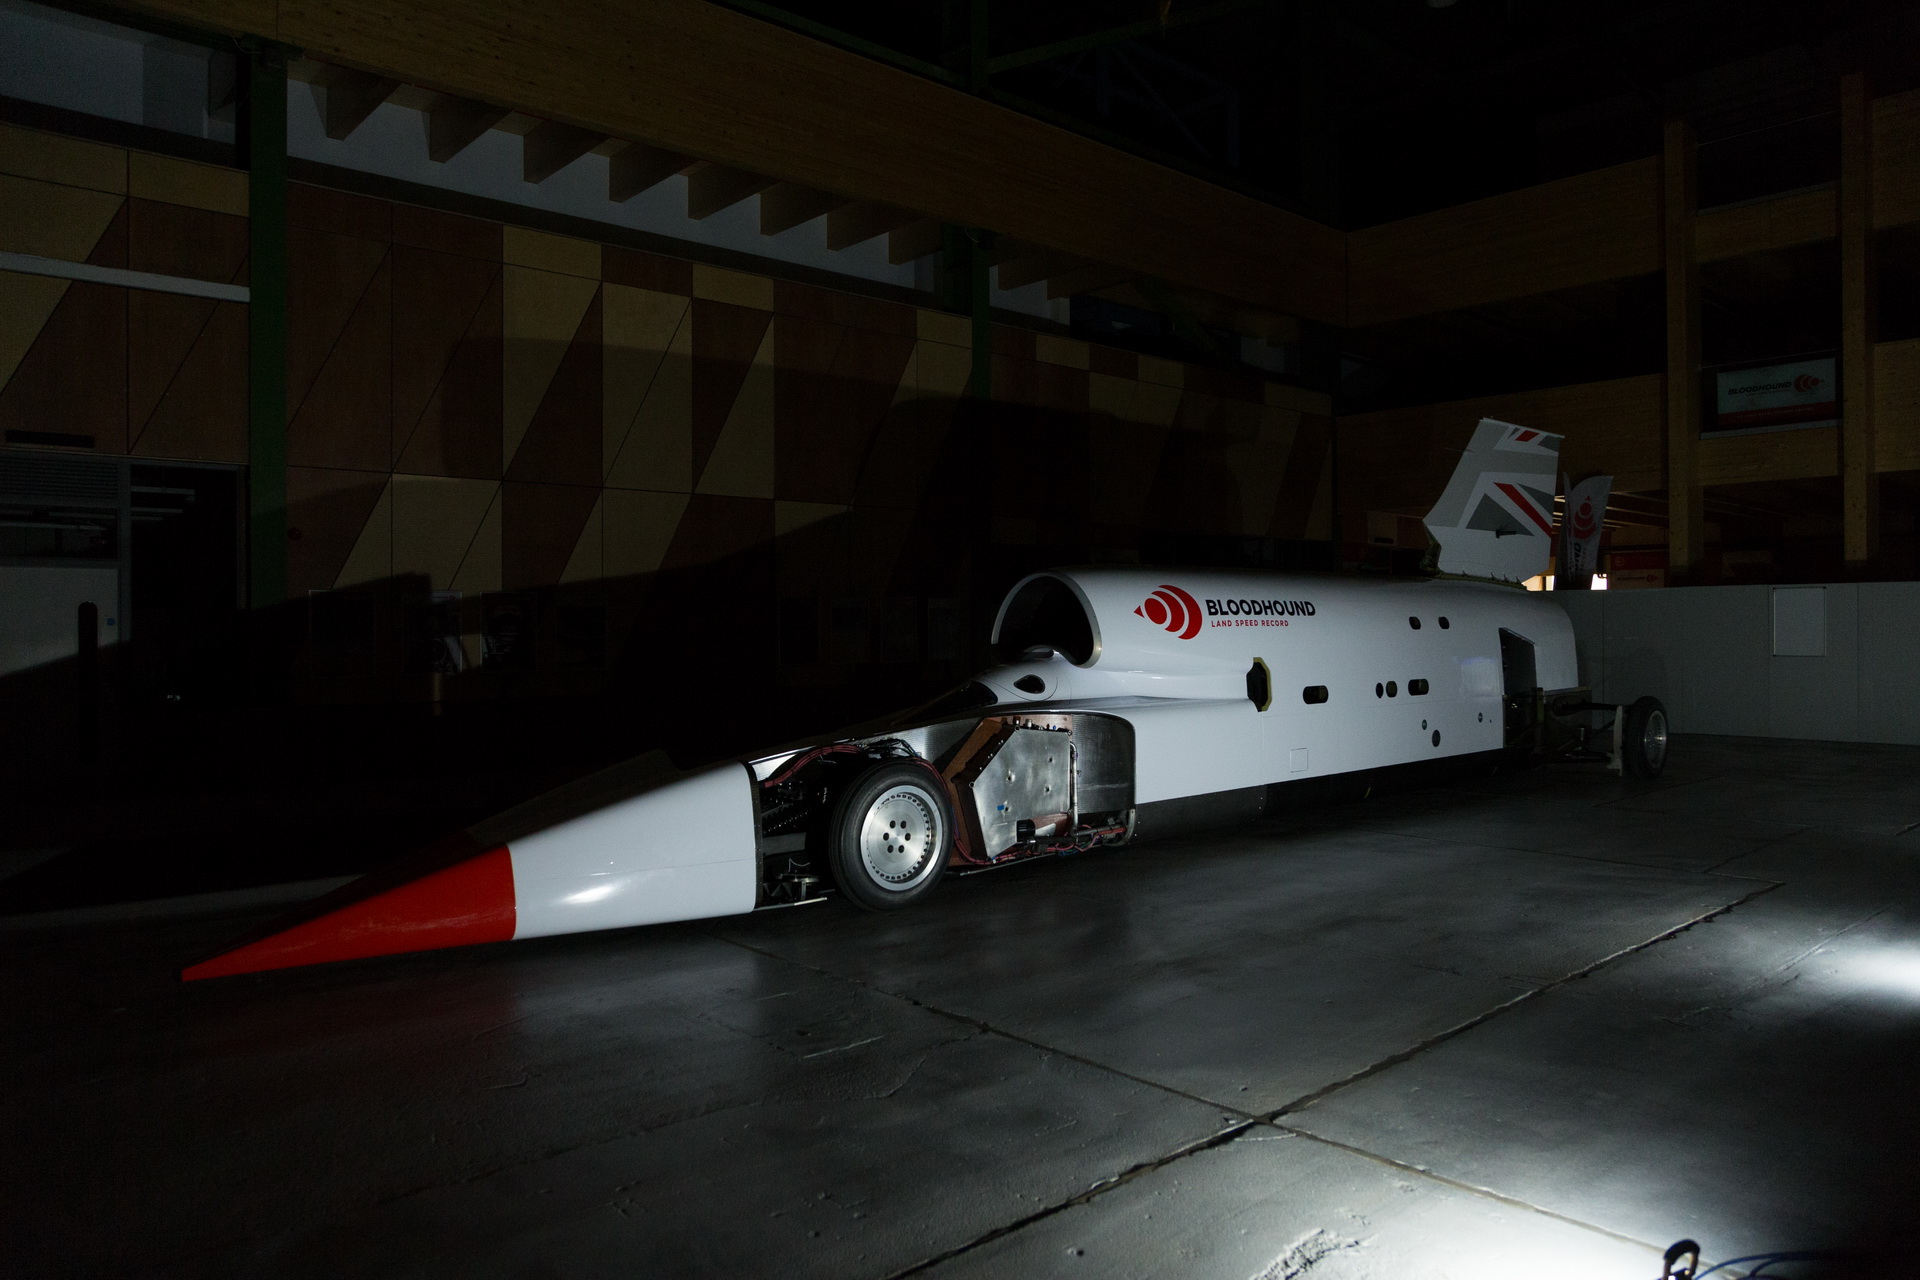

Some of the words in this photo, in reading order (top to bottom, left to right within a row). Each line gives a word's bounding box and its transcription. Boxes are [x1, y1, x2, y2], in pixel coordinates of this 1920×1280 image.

[1728, 381, 1792, 395] BLOODHOUND
[1205, 599, 1316, 616] BLOODHOUND
[1211, 619, 1233, 627] LAND
[1235, 619, 1259, 627] SPEED
[1261, 619, 1289, 627] RECORD
